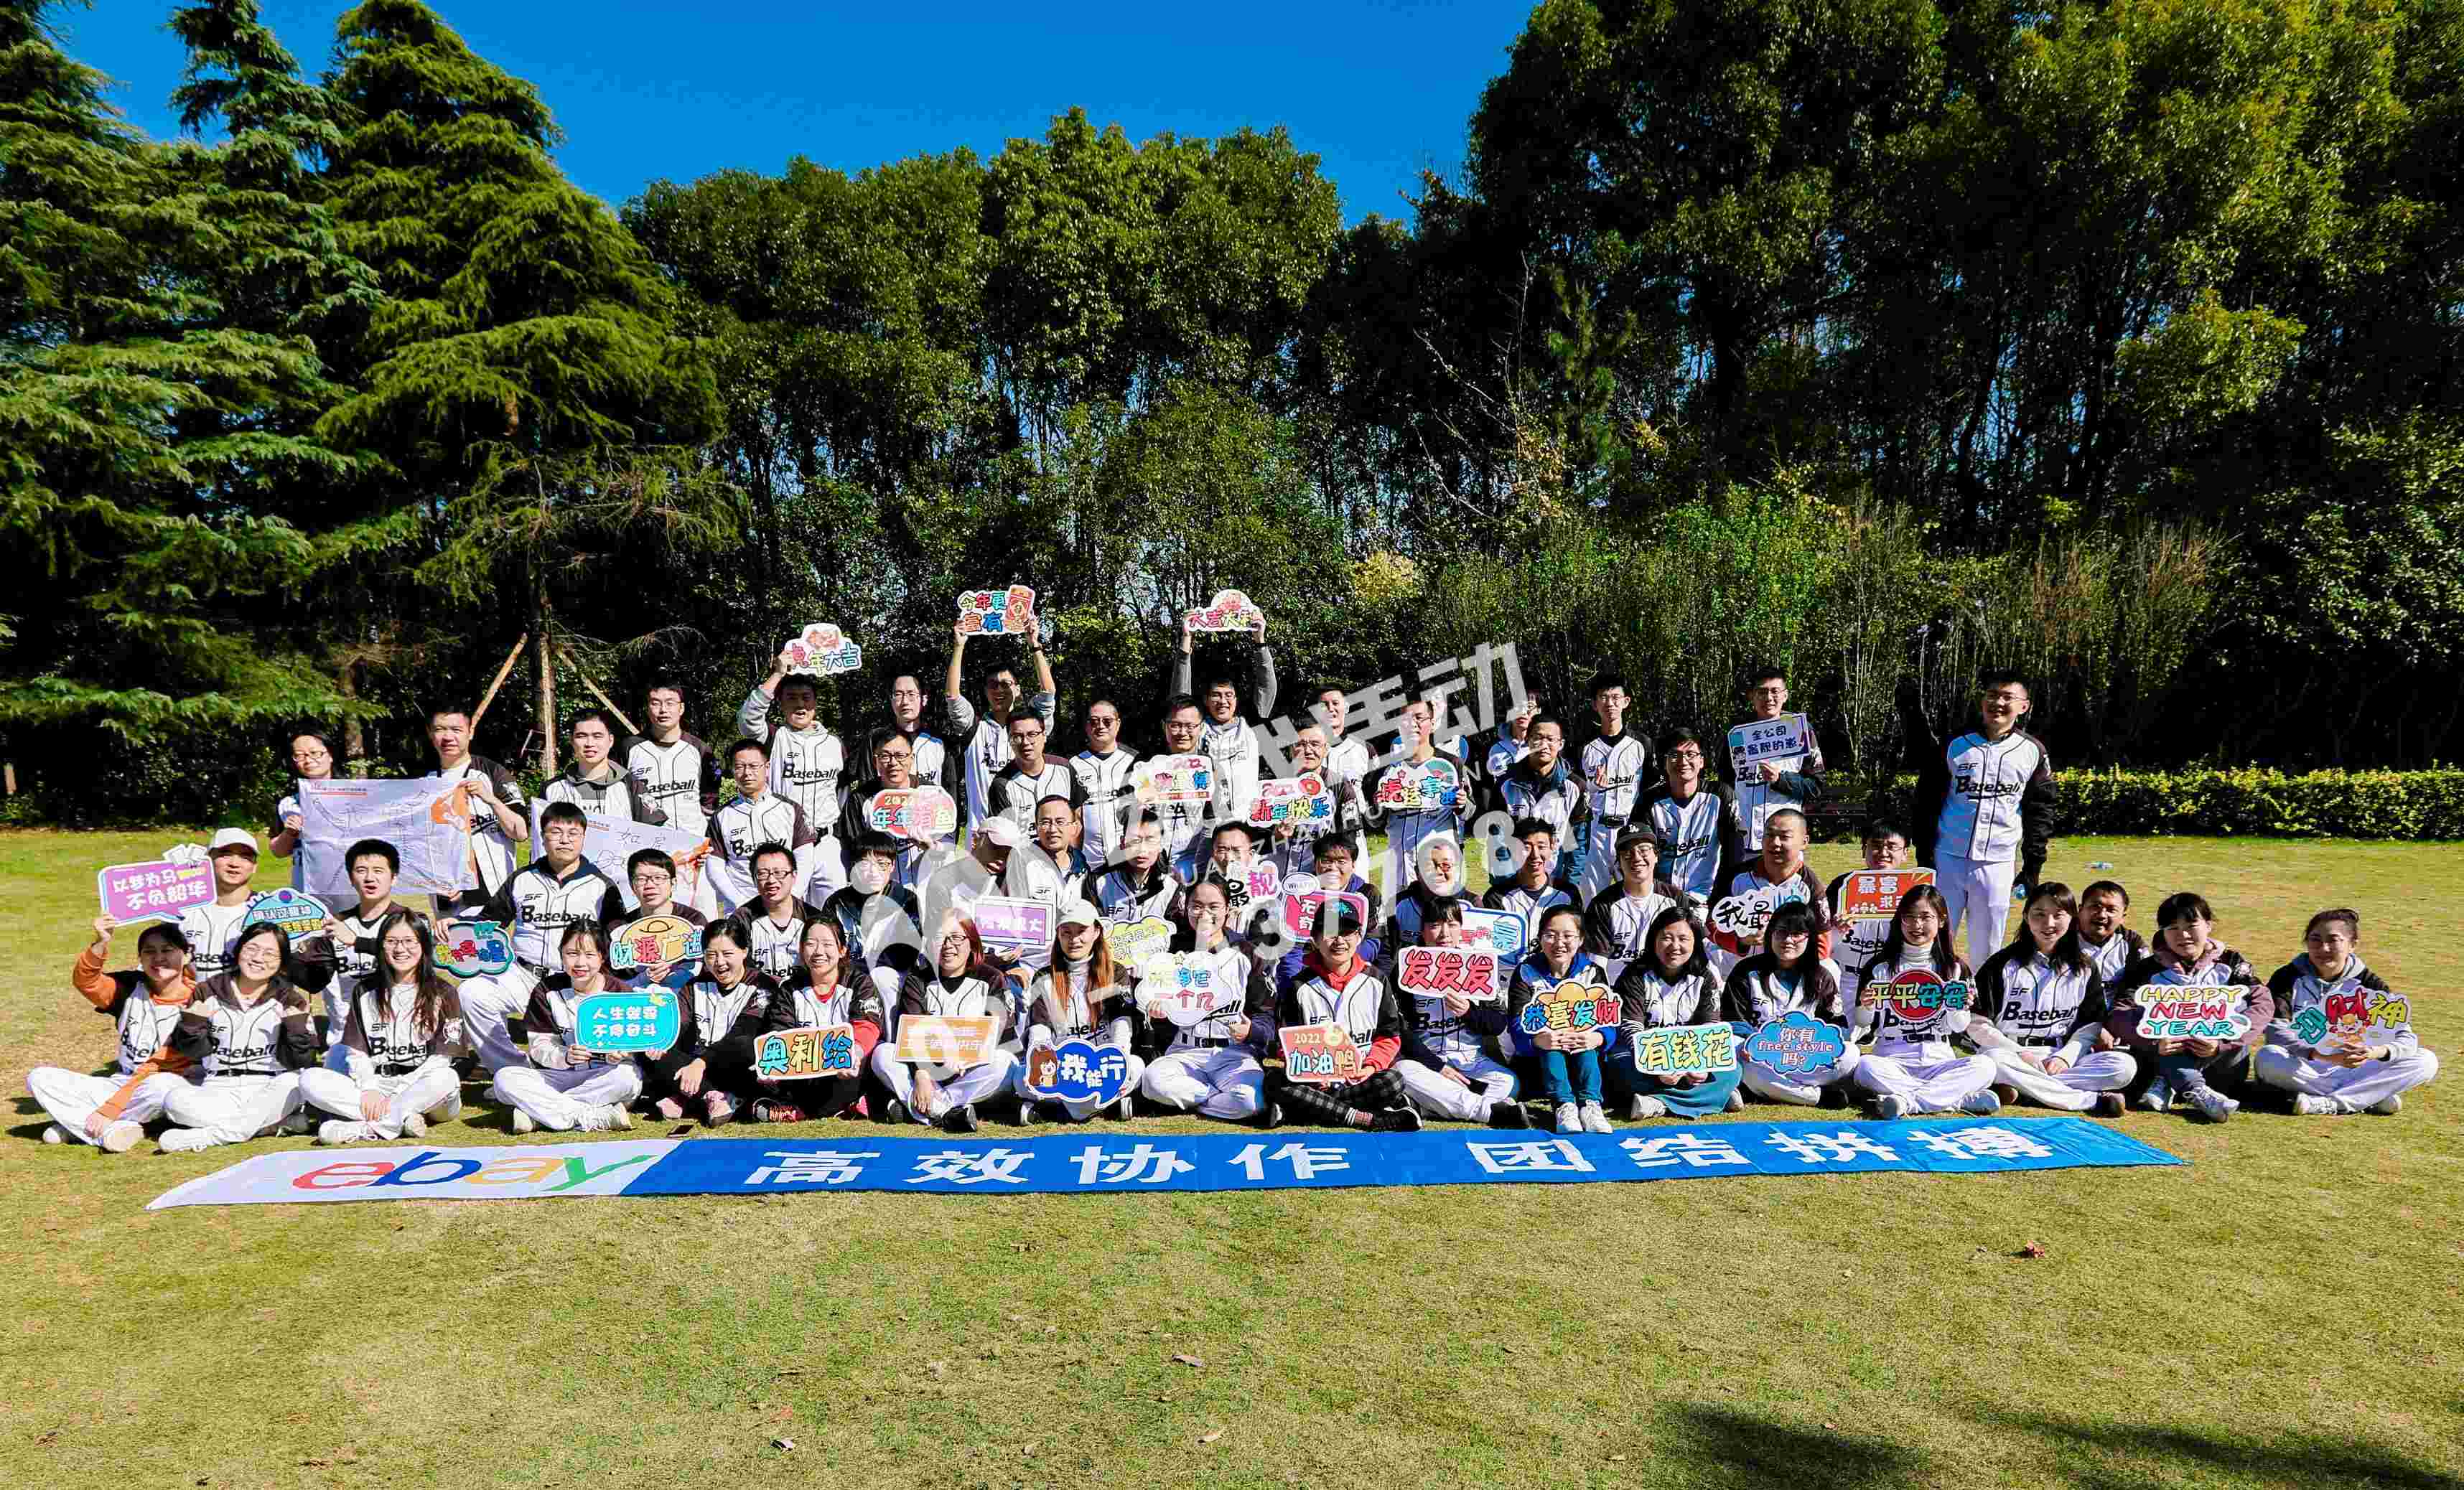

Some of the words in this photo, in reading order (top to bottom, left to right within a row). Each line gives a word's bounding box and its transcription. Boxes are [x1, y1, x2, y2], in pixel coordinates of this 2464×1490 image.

[1750, 724, 1788, 741] 全公司
[781, 760, 836, 780] Baseball
[918, 770, 937, 782] ball
[1737, 765, 1765, 782] Base
[1956, 762, 1977, 772] SF
[1955, 775, 2022, 795] Baseball
[1251, 797, 1330, 823] 新年快乐
[729, 828, 747, 837] SF
[113, 868, 178, 894] 以梦为马
[126, 881, 208, 911] 不负韶华
[1718, 899, 1771, 929] 我最
[754, 948, 770, 957] SF
[336, 956, 378, 973] Base
[1401, 949, 1494, 995] 发发发
[1154, 988, 1215, 1012] 一个亿
[1870, 982, 1967, 1010] 平平安安
[2010, 988, 2032, 996] SF
[2140, 987, 2241, 1002] HAPPY
[1523, 999, 1620, 1031] 恭喜发财
[2150, 1001, 2226, 1020] NEW
[371, 1022, 390, 1032] SF
[1310, 1016, 1327, 1025] SF
[2149, 1019, 2235, 1038] YEAR
[1293, 1033, 1320, 1044] 2022
[1780, 1026, 1816, 1041] 你有
[757, 1031, 854, 1075] 奥利给
[1639, 1029, 1734, 1072] 有钱花
[1758, 1041, 1792, 1052] free
[1795, 1041, 1834, 1053] style
[1060, 1052, 1126, 1089] 我能行
[1289, 1047, 1358, 1076] 加油鸭
[744, 1143, 1353, 1184] 高效协作
[1465, 1125, 2053, 1173] 团结拼搏
[291, 1152, 661, 1191] ebay
